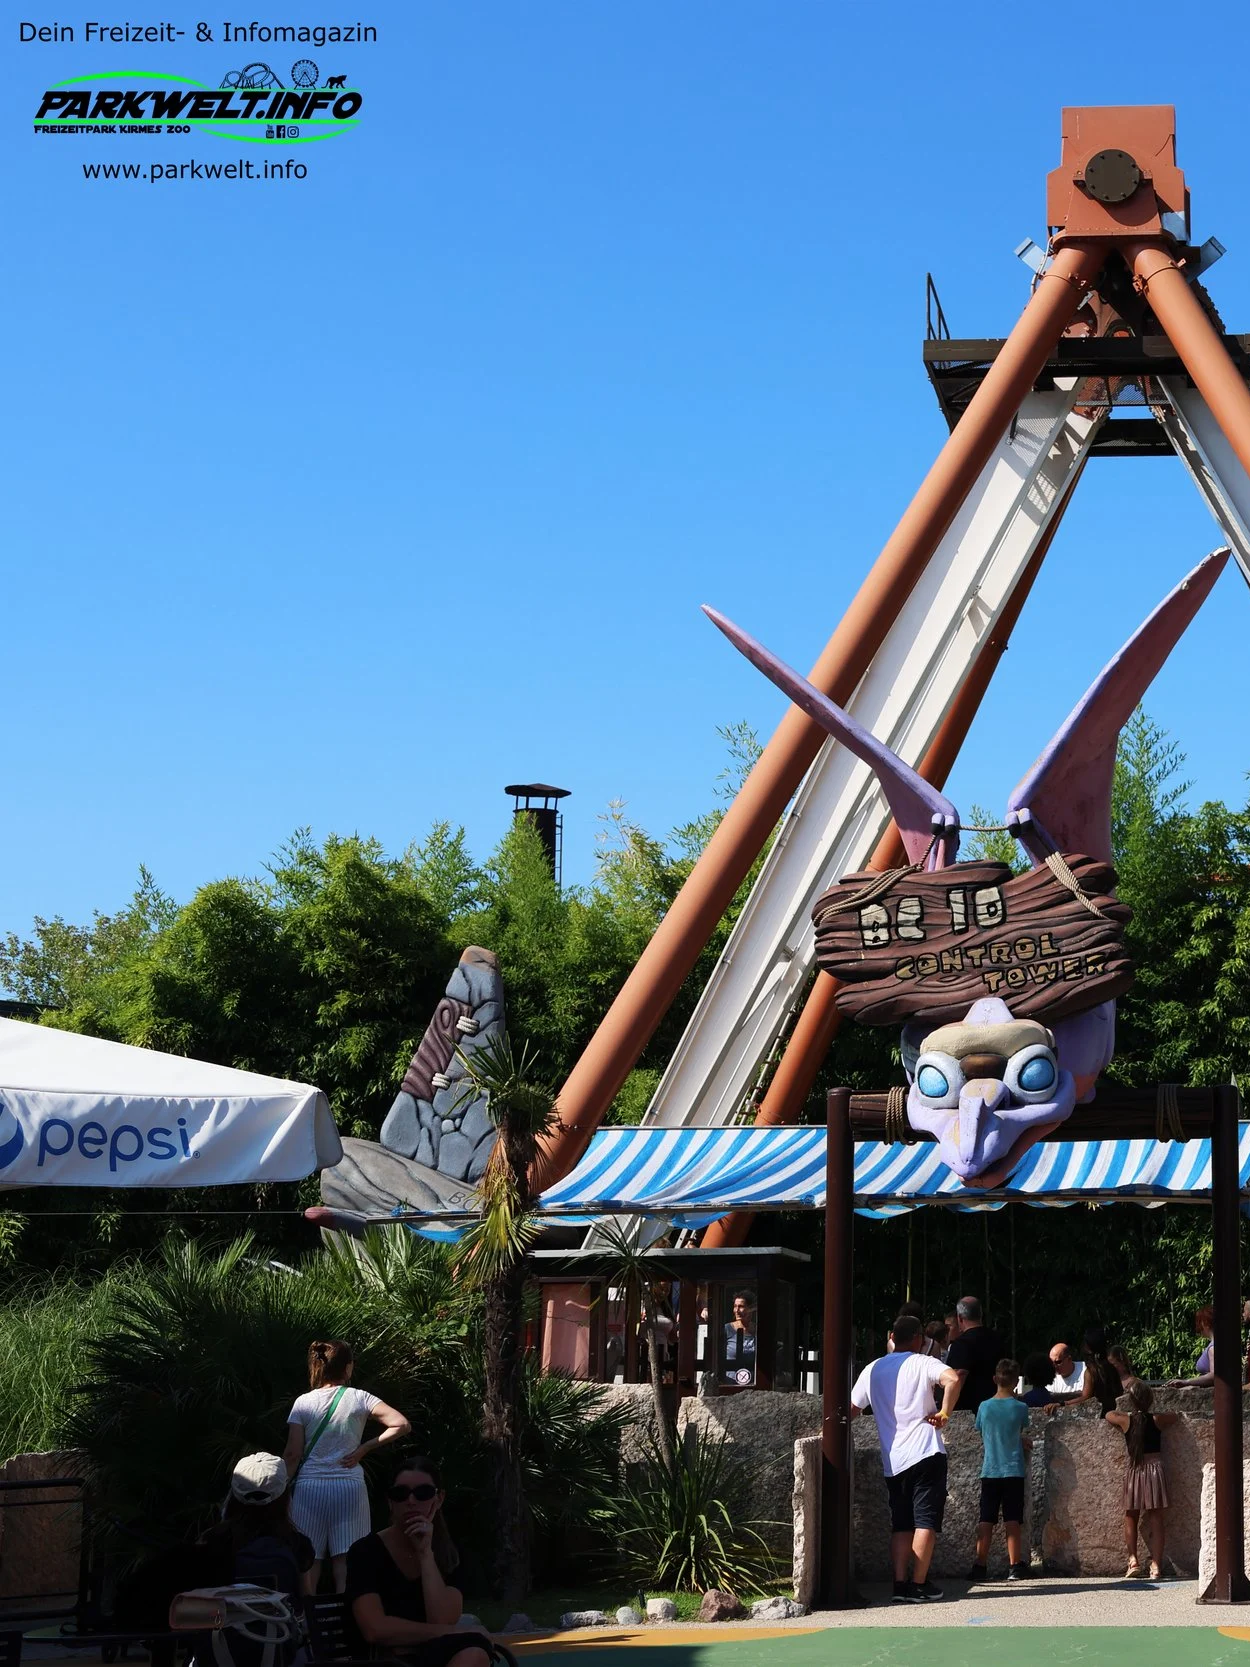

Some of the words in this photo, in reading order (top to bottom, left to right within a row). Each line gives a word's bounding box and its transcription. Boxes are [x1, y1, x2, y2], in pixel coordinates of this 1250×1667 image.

[857, 896, 926, 949] BC
[894, 933, 1060, 981] CONTROL
[982, 953, 1110, 994] TOWER
